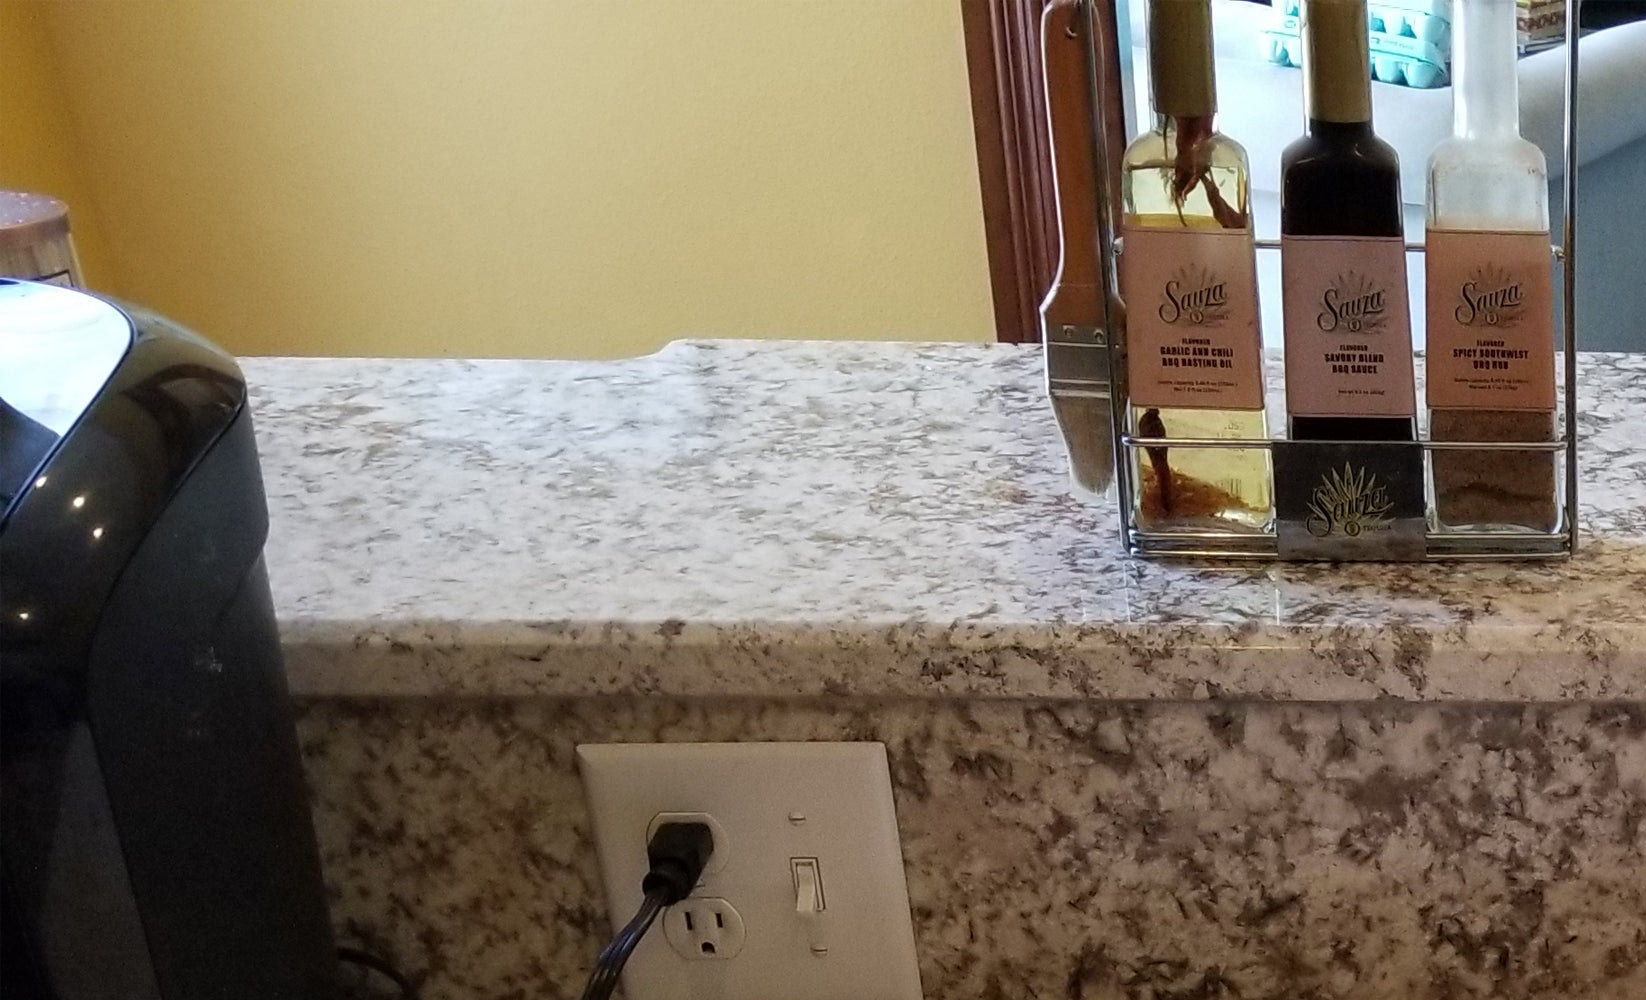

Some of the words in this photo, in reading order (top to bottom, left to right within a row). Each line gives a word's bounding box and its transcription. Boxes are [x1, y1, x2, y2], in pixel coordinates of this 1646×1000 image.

[1159, 280, 1227, 324] Sauza
[1455, 282, 1523, 324] Sauza
[1317, 289, 1386, 331] Sauza
[1160, 347, 1190, 356] GARLIC
[1192, 347, 1209, 356] AND
[1211, 347, 1234, 356] CHILI
[1453, 349, 1477, 358] SPICY
[1479, 349, 1528, 359] SOUTHWEST
[1162, 358, 1180, 368] BBQ
[1181, 358, 1218, 368] BASTING
[1220, 358, 1232, 368] OIL
[1325, 353, 1356, 362] SAVORY
[1358, 354, 1384, 363] BLEND
[1332, 365, 1348, 374] BBQ
[1351, 365, 1377, 374] SAUCE
[1473, 360, 1489, 369] BBQ
[1492, 360, 1508, 369] RUB
[1306, 486, 1391, 538] Sauza
